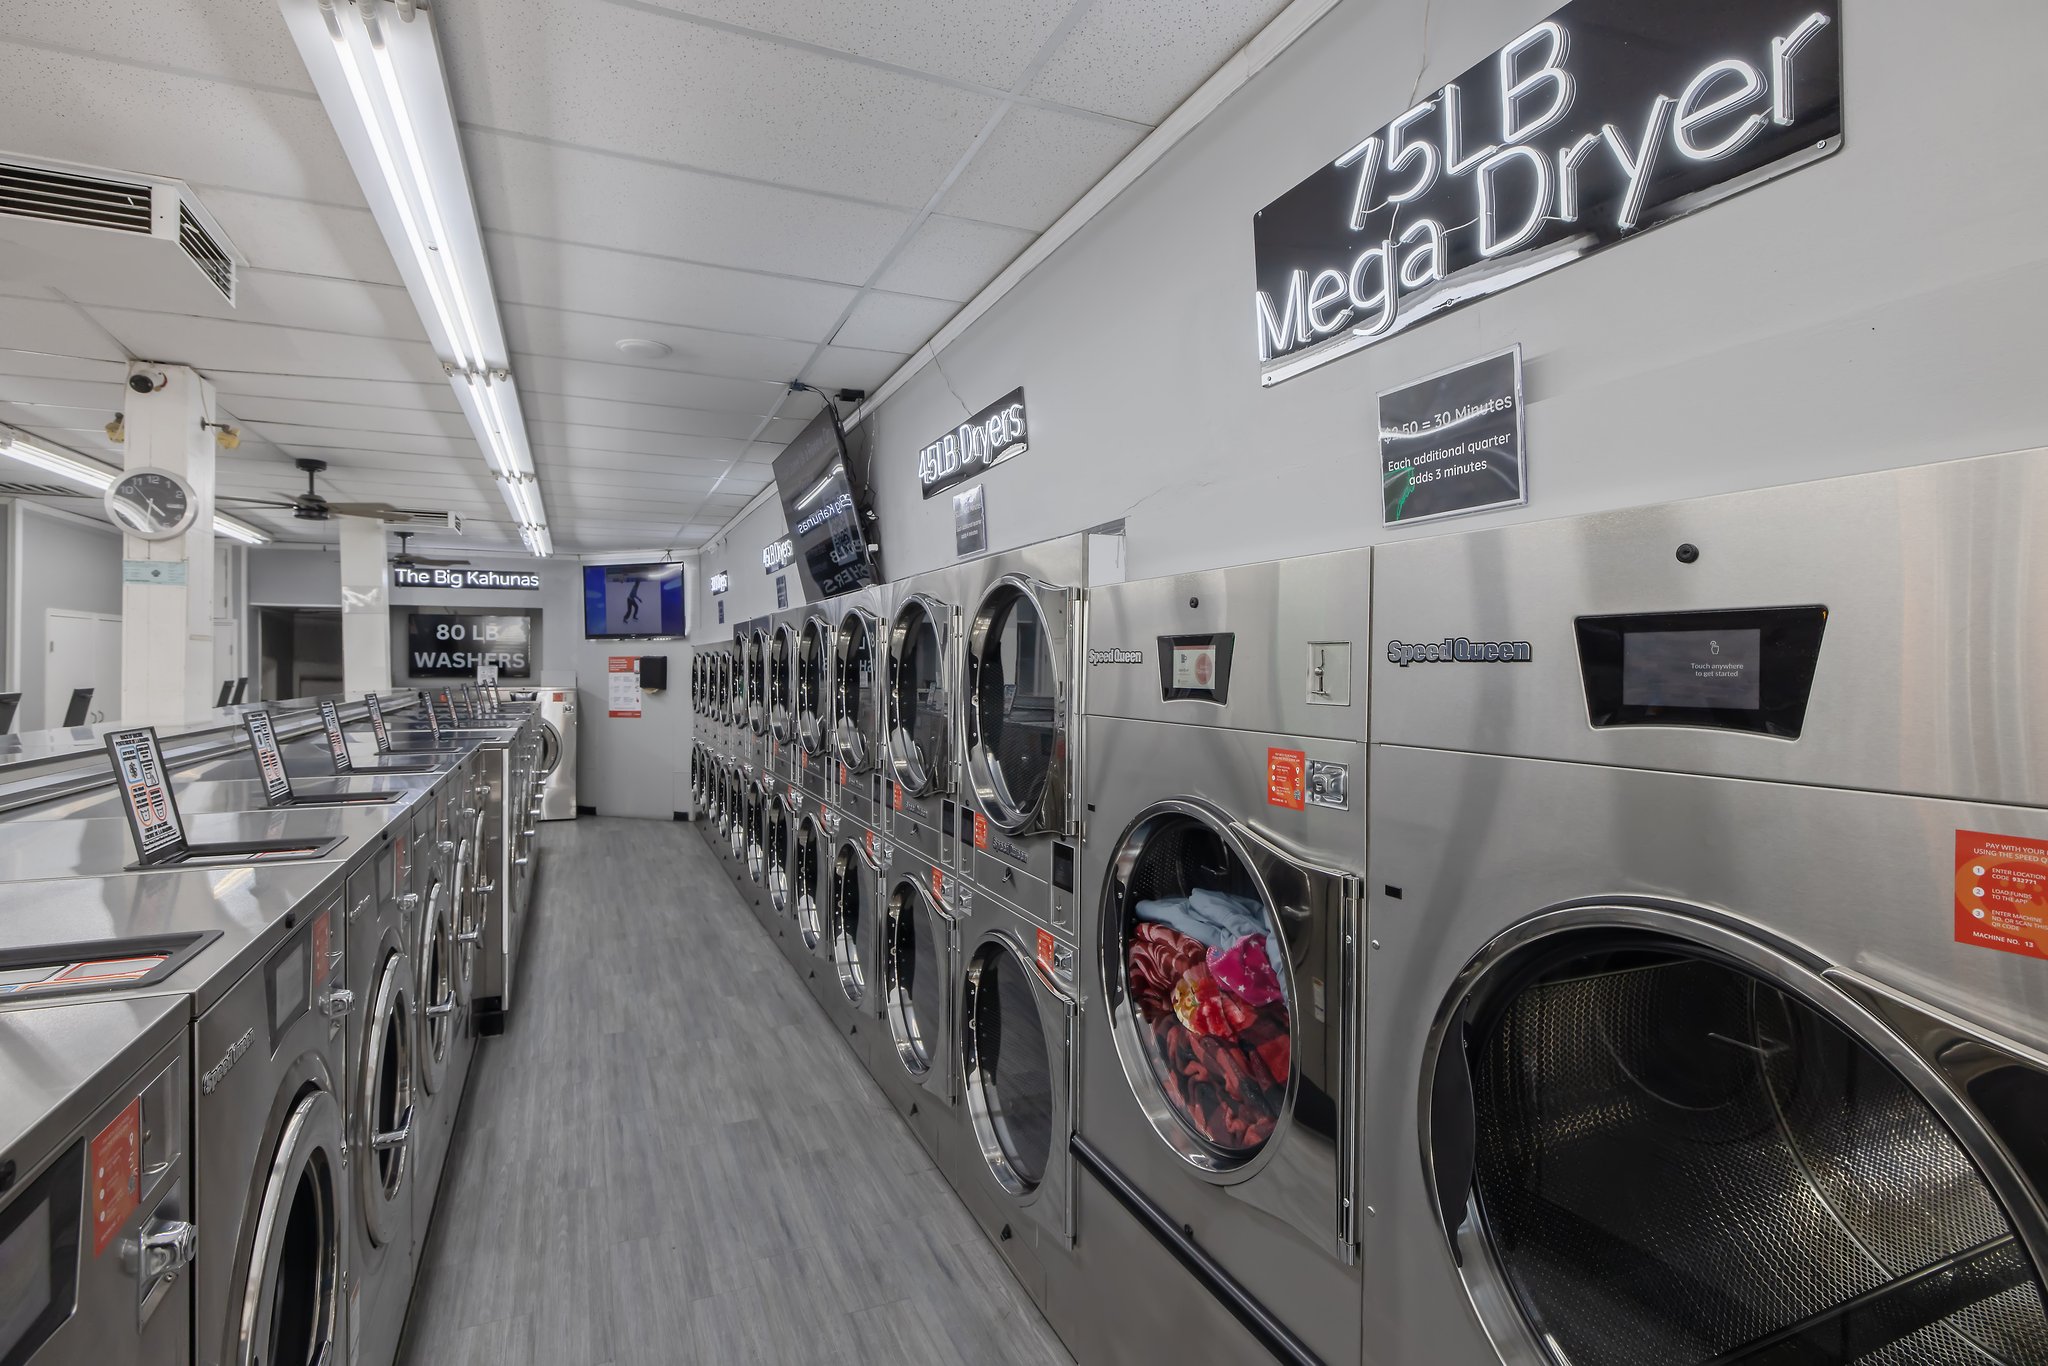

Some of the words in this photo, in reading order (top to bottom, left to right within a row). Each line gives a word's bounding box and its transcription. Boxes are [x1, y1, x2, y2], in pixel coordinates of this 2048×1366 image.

[1335, 21, 1577, 231] 75LB
[1256, 217, 1448, 362] Mega
[1476, 12, 1831, 256] Dryer
[1384, 420, 1418, 444] $250
[1434, 411, 1450, 428] 30
[1455, 395, 1513, 420] Minutes
[959, 403, 1026, 464] Dryers
[1388, 457, 1411, 472] Each
[1413, 443, 1465, 466] additional
[1467, 432, 1511, 453] quarter
[146, 475, 160, 484] 12
[1409, 469, 1434, 486] adds
[1435, 468, 1442, 480] 3
[1444, 460, 1487, 478] minutes
[120, 486, 134, 495] 10
[395, 568, 430, 584] The
[434, 569, 463, 588] Big
[466, 571, 540, 587] Kahunas
[436, 624, 466, 641] 80
[472, 624, 499, 641] LB
[414, 652, 525, 668] WASHERS
[1973, 848, 1997, 857] USING
[1999, 851, 2014, 859] THE
[2014, 853, 2039, 862] SPEED
[2022, 847, 2045, 855] YOUR
[1992, 867, 2012, 875] ENTER
[2013, 871, 2046, 880] LOCATION
[1992, 873, 2010, 881] CODE
[2012, 877, 2037, 885] 932771
[1992, 888, 2009, 896] LOAD
[2010, 891, 2032, 899] FUNDS
[2002, 895, 2014, 903] THE
[1992, 909, 2012, 918] ENTER
[2012, 913, 2043, 923] MACHINE
[2015, 919, 2032, 927] SCAN
[2002, 923, 2020, 931] CODE
[1972, 931, 2005, 943] MACHINE
[2006, 937, 2021, 946] NO.
